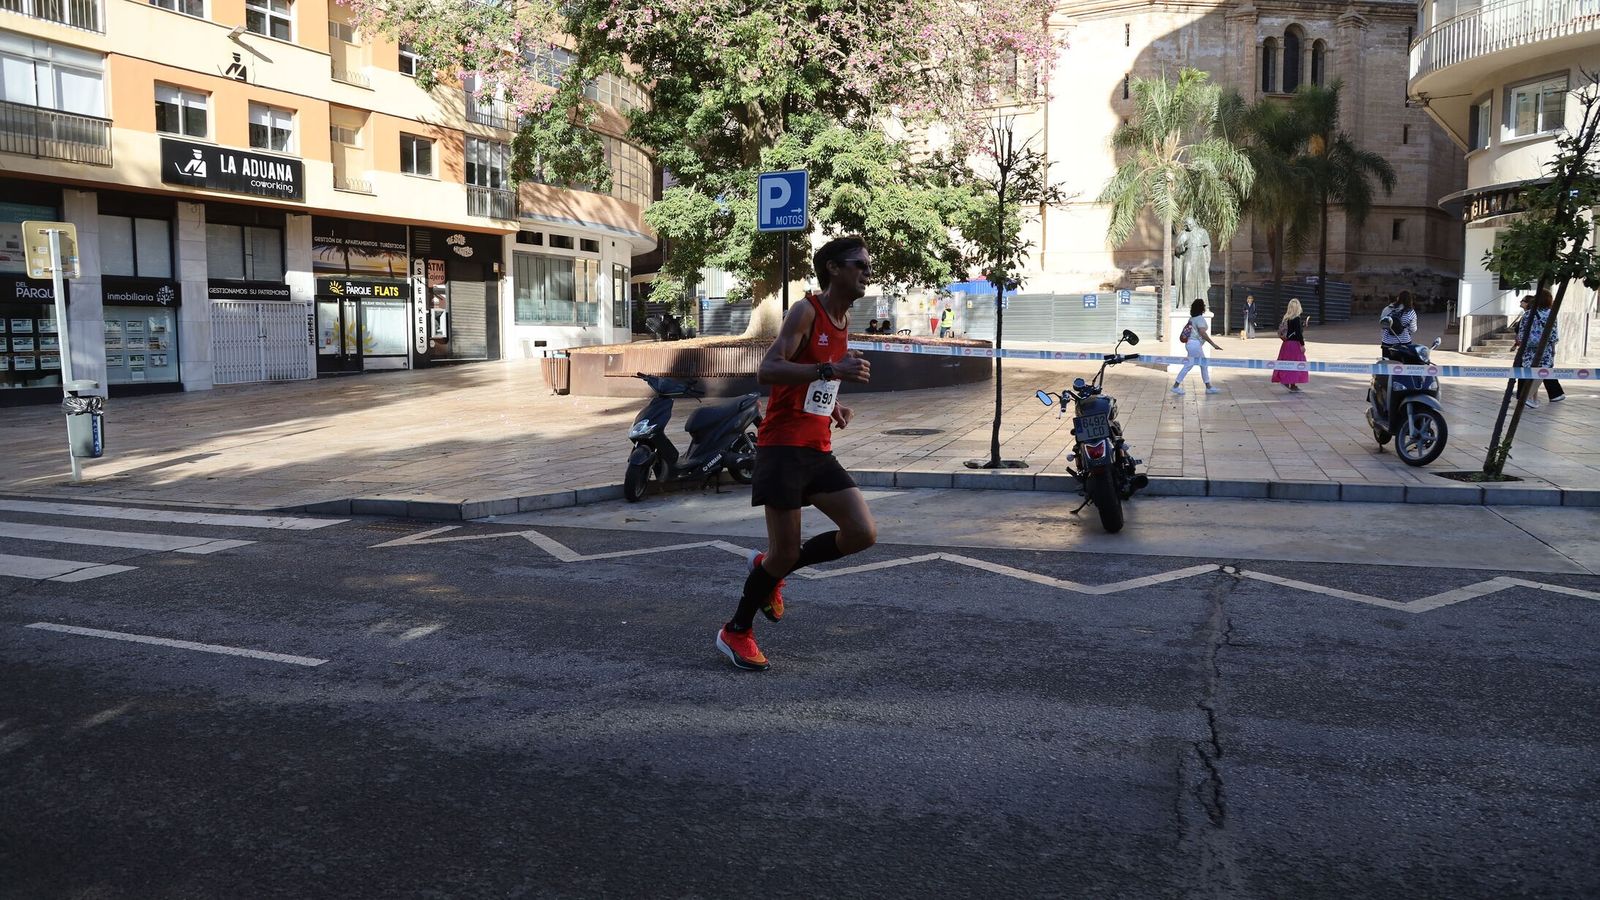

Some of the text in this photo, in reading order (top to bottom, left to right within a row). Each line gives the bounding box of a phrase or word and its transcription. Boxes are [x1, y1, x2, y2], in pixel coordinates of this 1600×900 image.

[220, 154, 293, 182] LA ADUANA
[250, 180, 293, 193] coworking
[762, 177, 792, 224] P
[776, 214, 803, 225] MOTOS
[428, 263, 444, 272] ATM
[16, 288, 54, 299] PARQU
[208, 287, 247, 295] GESTIONAMOS
[346, 285, 399, 296] PARQUE FLATS
[107, 292, 153, 301] inmobiliaria
[1082, 416, 1106, 429] 6492
